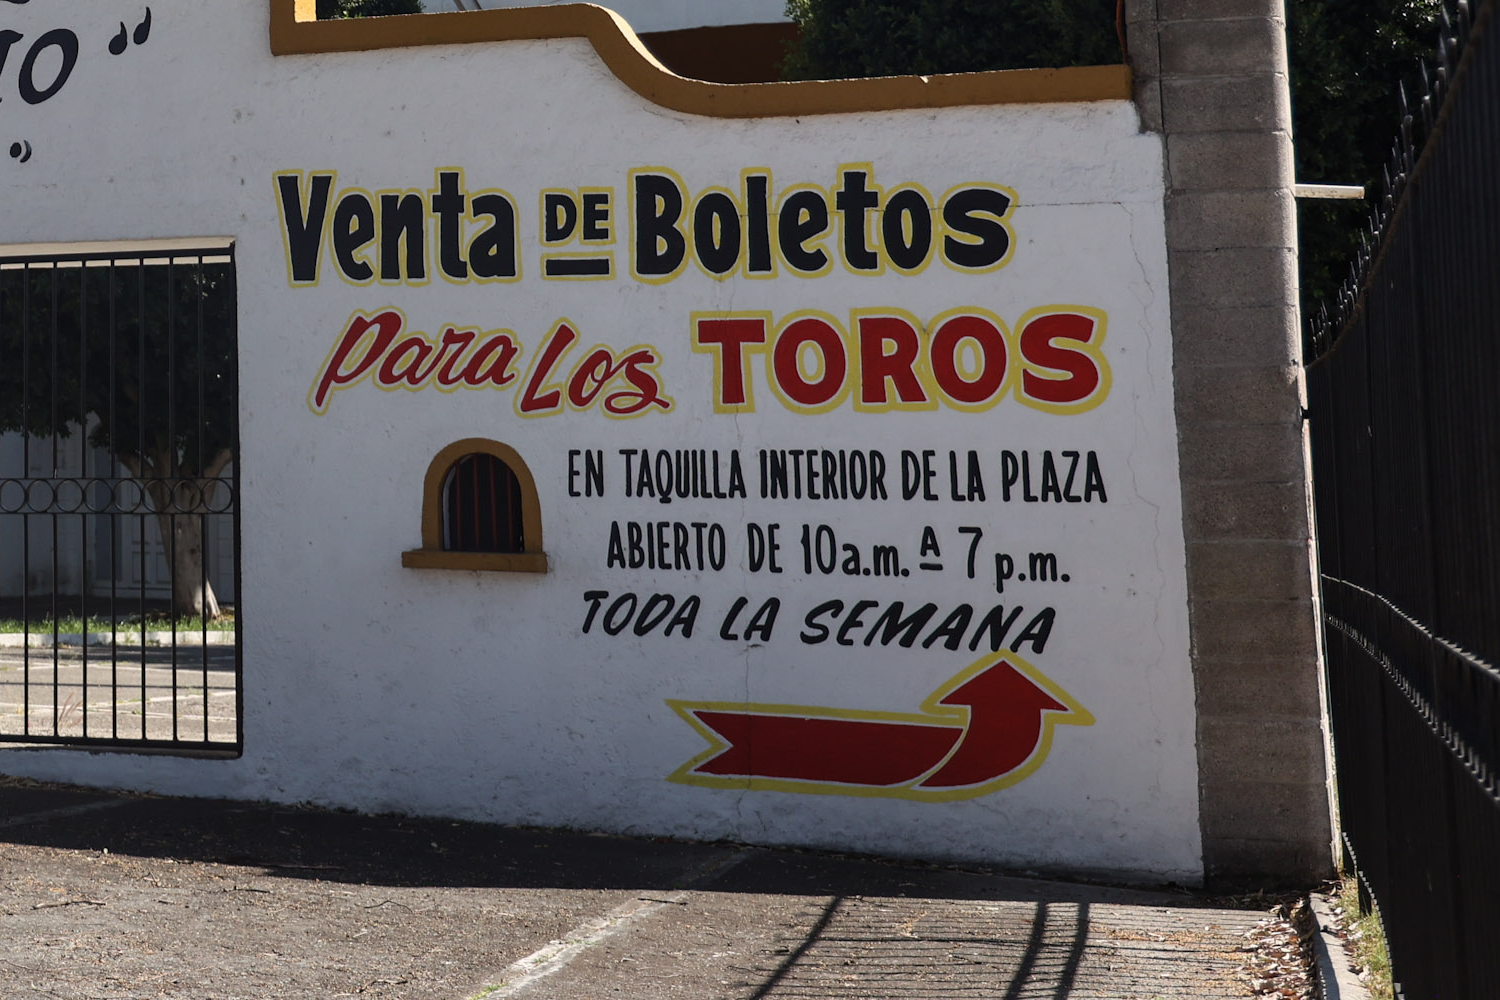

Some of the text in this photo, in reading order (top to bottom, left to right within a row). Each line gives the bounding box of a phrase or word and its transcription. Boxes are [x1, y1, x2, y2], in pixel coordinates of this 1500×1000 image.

[277, 171, 1012, 282] Venta DE Boletos
[520, 323, 674, 414] Los
[697, 313, 1100, 405] TOROS
[568, 448, 1109, 504] EN TAQUILLA INTERIOR DE LA PLAZA
[606, 520, 727, 572] ABIERTO
[747, 522, 783, 574] DE
[919, 525, 943, 560] A
[957, 526, 984, 579] 7
[994, 551, 1071, 594] p.m.
[582, 590, 1057, 655] TODA LA SEMANA
